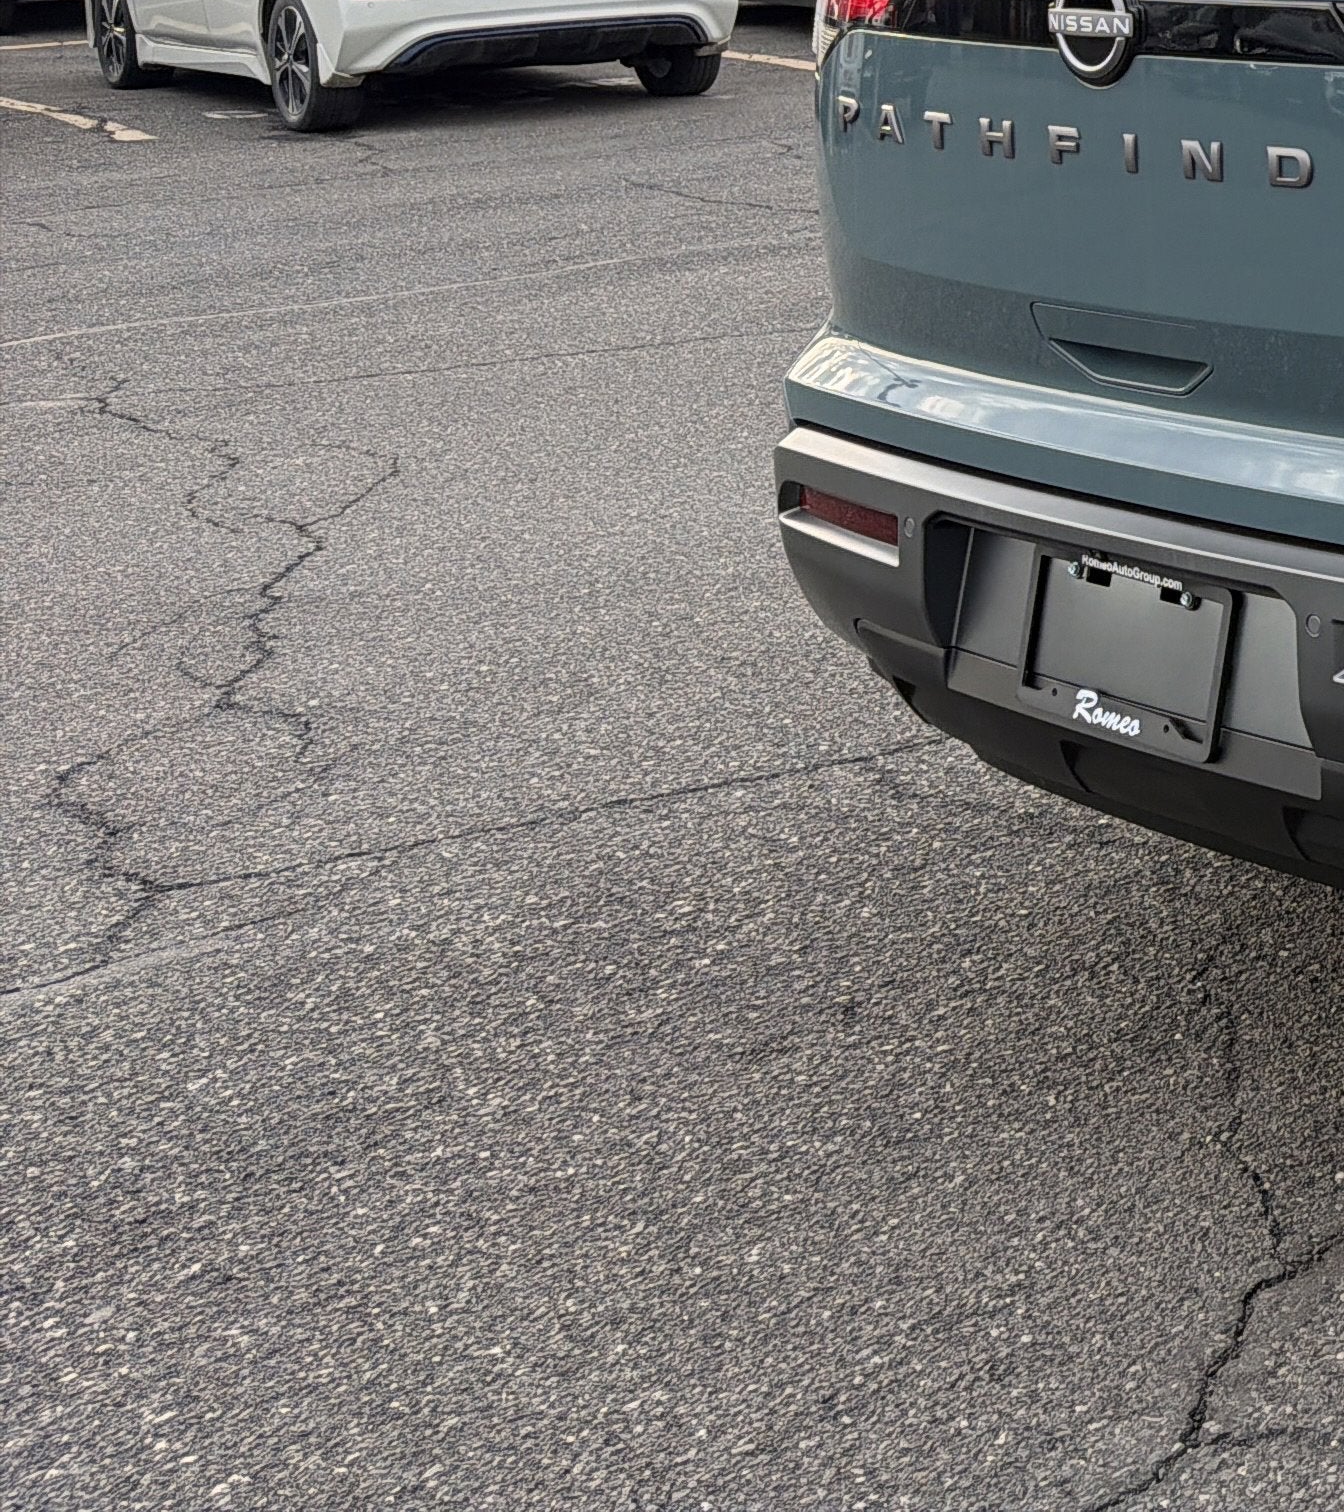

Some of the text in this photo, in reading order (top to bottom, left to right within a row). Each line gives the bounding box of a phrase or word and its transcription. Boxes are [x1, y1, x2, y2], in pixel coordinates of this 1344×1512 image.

[1048, 13, 1130, 35] NISSAN
[1081, 554, 1183, 591] RomeoAutoGroup.com
[1072, 689, 1141, 737] Romeo
